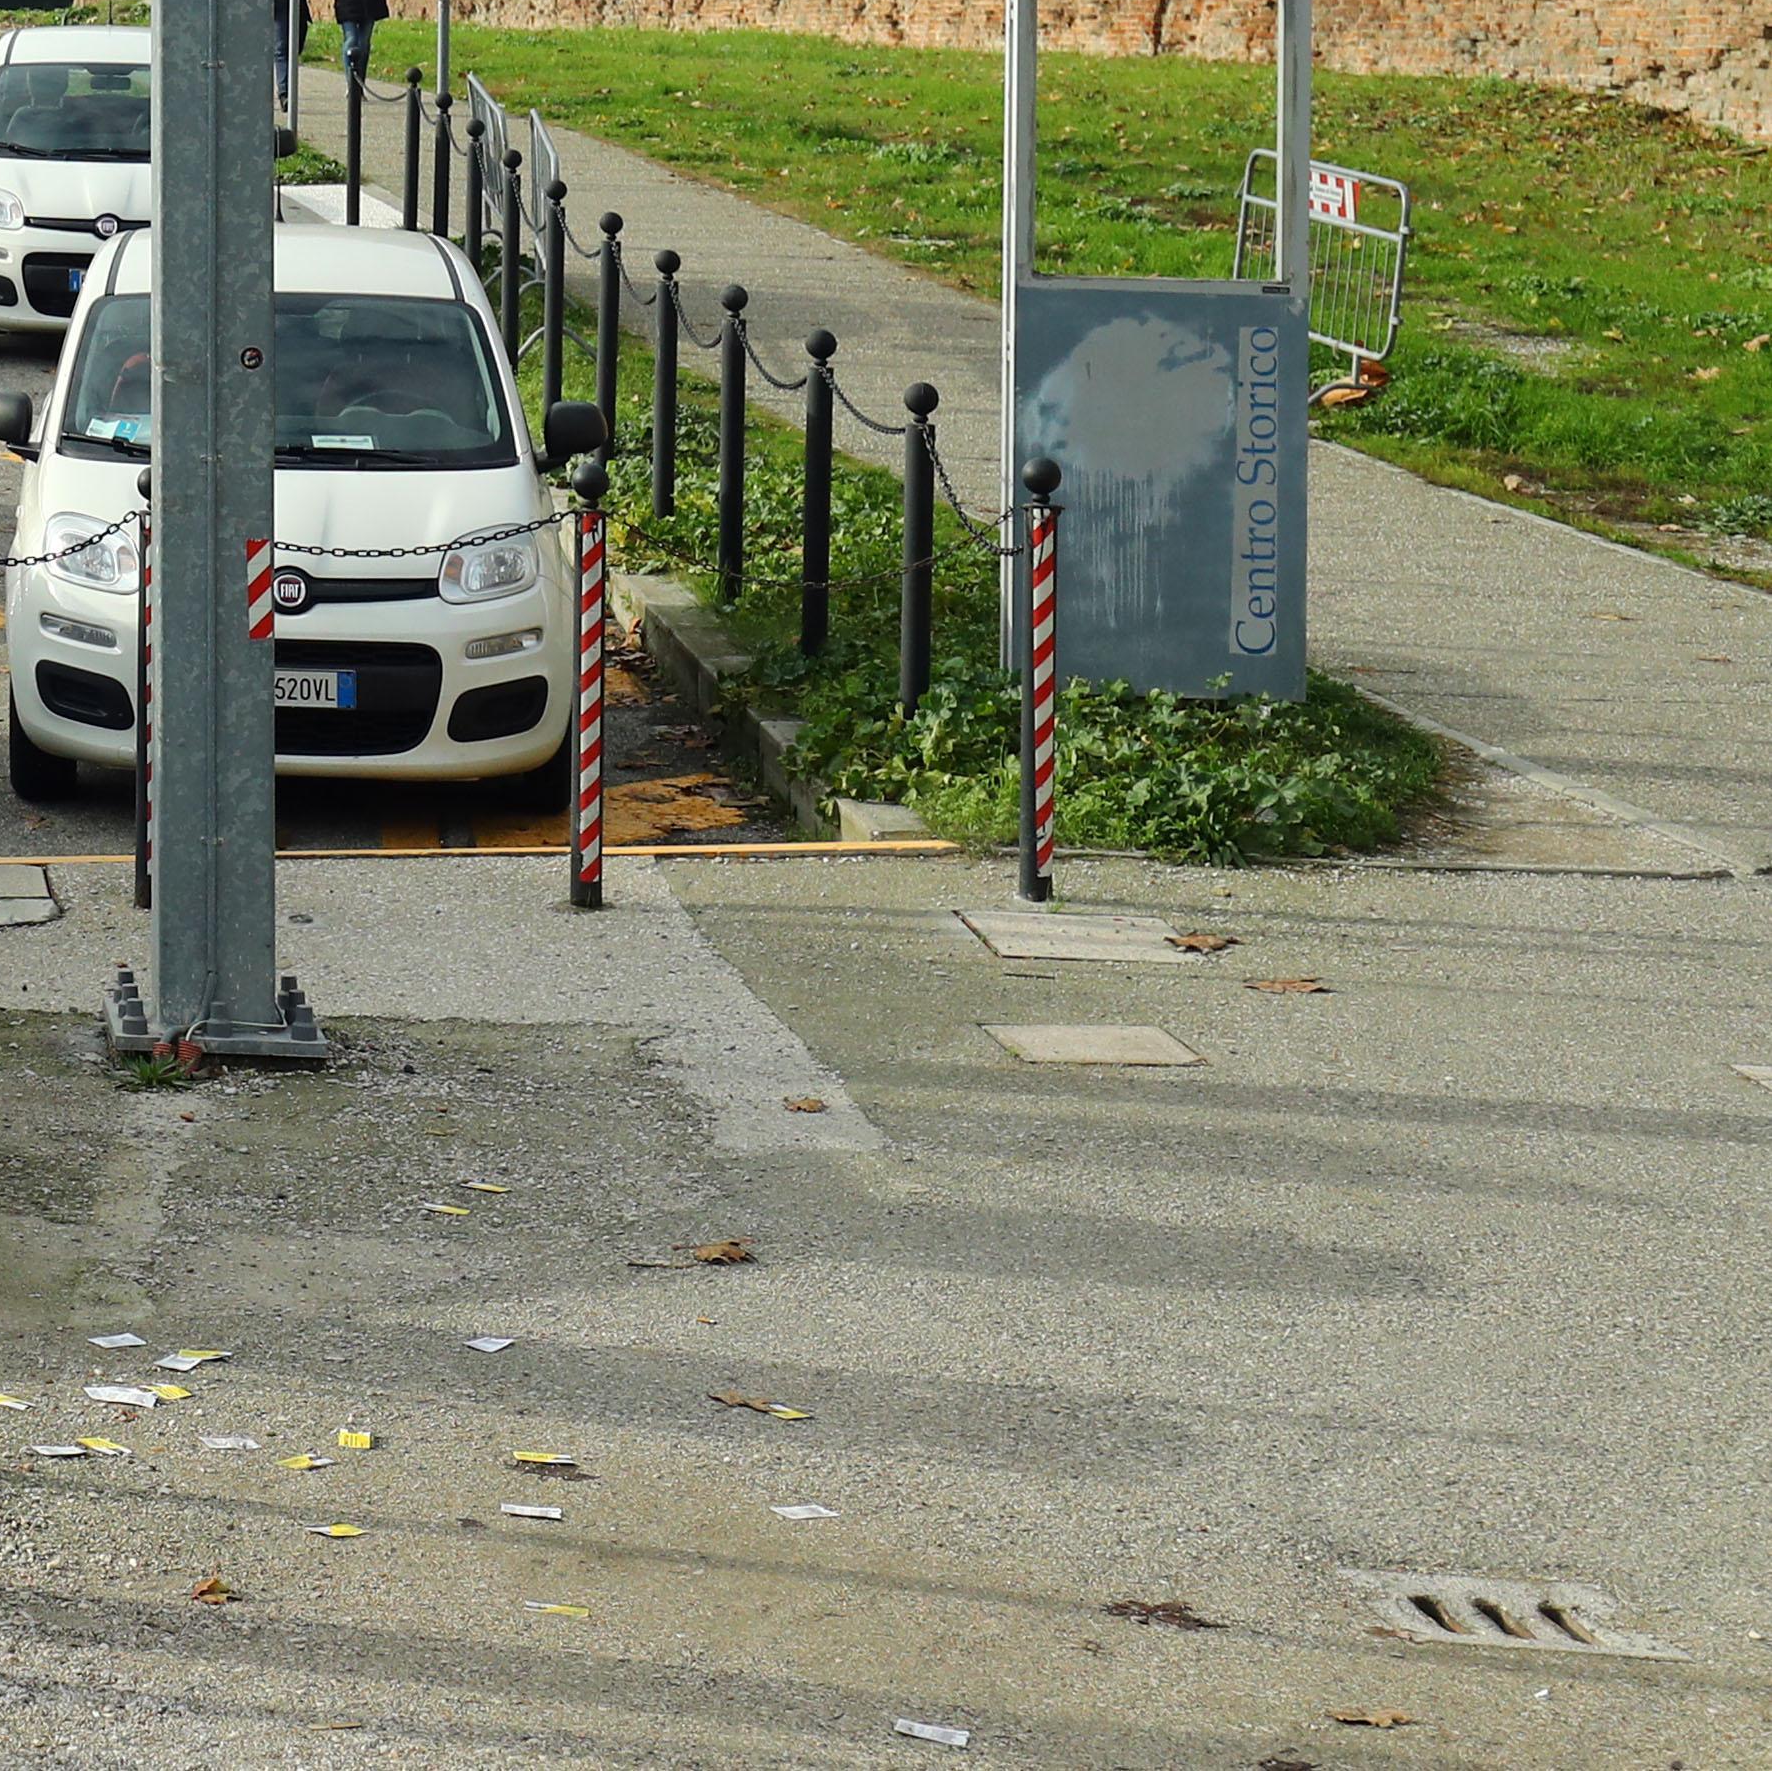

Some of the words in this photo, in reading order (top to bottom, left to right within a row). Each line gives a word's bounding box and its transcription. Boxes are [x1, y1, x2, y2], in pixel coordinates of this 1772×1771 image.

[1236, 327, 1279, 486] Storico
[280, 583, 299, 599] FIAT
[1234, 499, 1278, 656] Centro
[274, 676, 336, 702] 520VL
